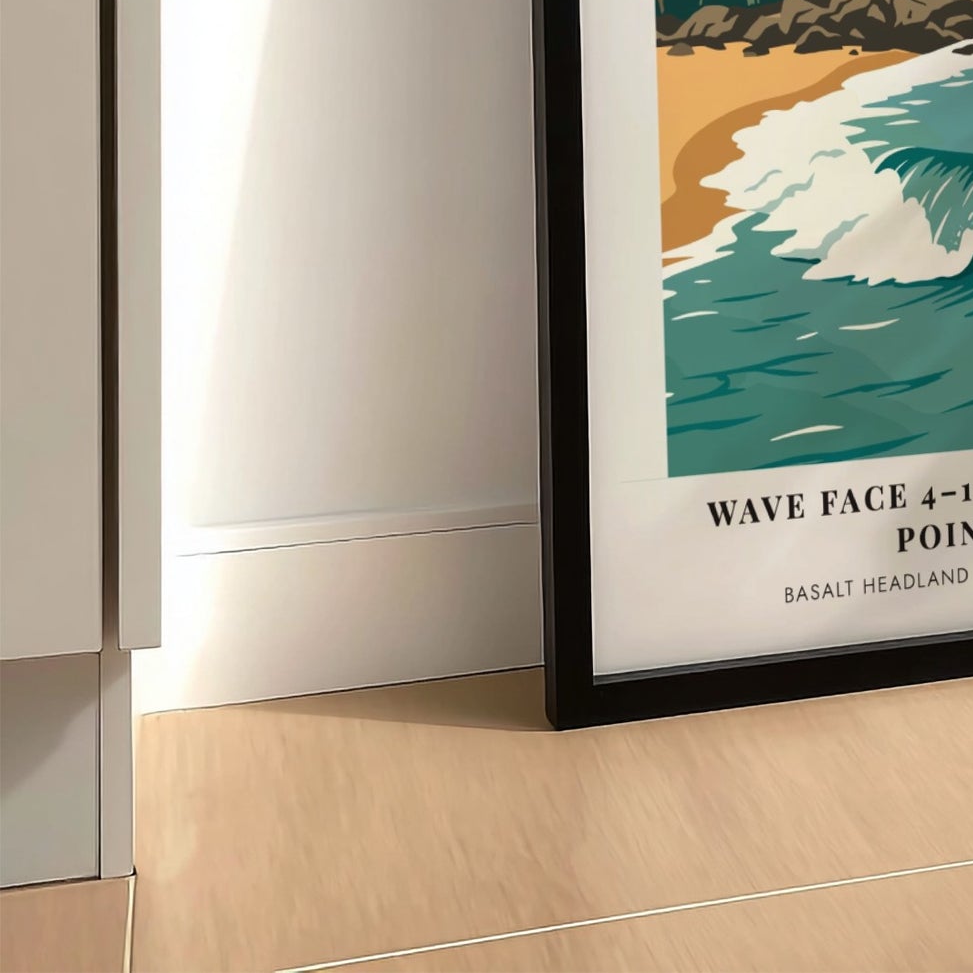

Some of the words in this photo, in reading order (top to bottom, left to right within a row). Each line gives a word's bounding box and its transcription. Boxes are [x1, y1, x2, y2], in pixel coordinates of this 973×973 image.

[706, 493, 805, 527] WAVE
[820, 482, 907, 517] FACE
[784, 579, 854, 604] BASALT
[863, 567, 969, 595] HEADLAND
